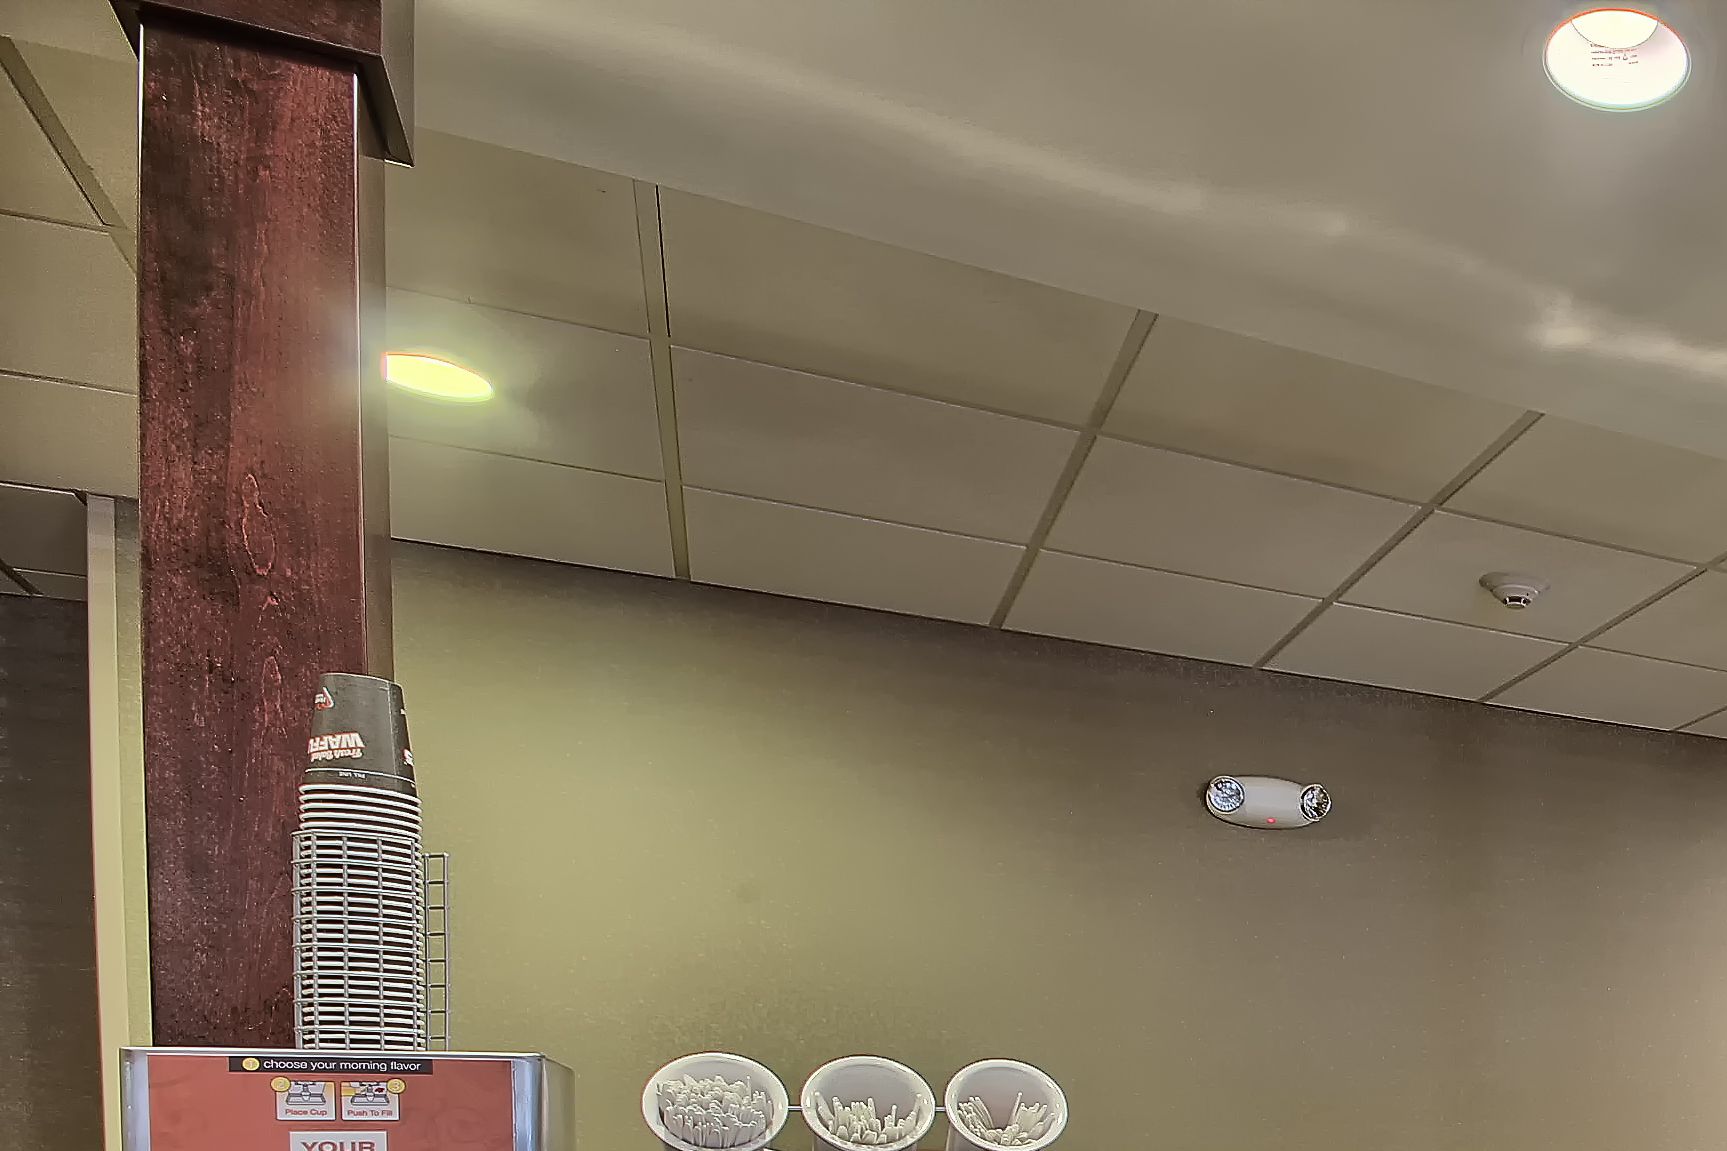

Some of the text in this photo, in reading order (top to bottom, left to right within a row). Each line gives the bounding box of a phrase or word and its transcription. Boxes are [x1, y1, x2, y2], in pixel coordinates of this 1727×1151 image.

[263, 1059, 308, 1069] choose
[310, 1061, 337, 1072] your
[340, 1060, 387, 1072] morning
[390, 1061, 422, 1071] flavor
[284, 1108, 328, 1117] Place Cup
[347, 1109, 393, 1117] Push To Fill
